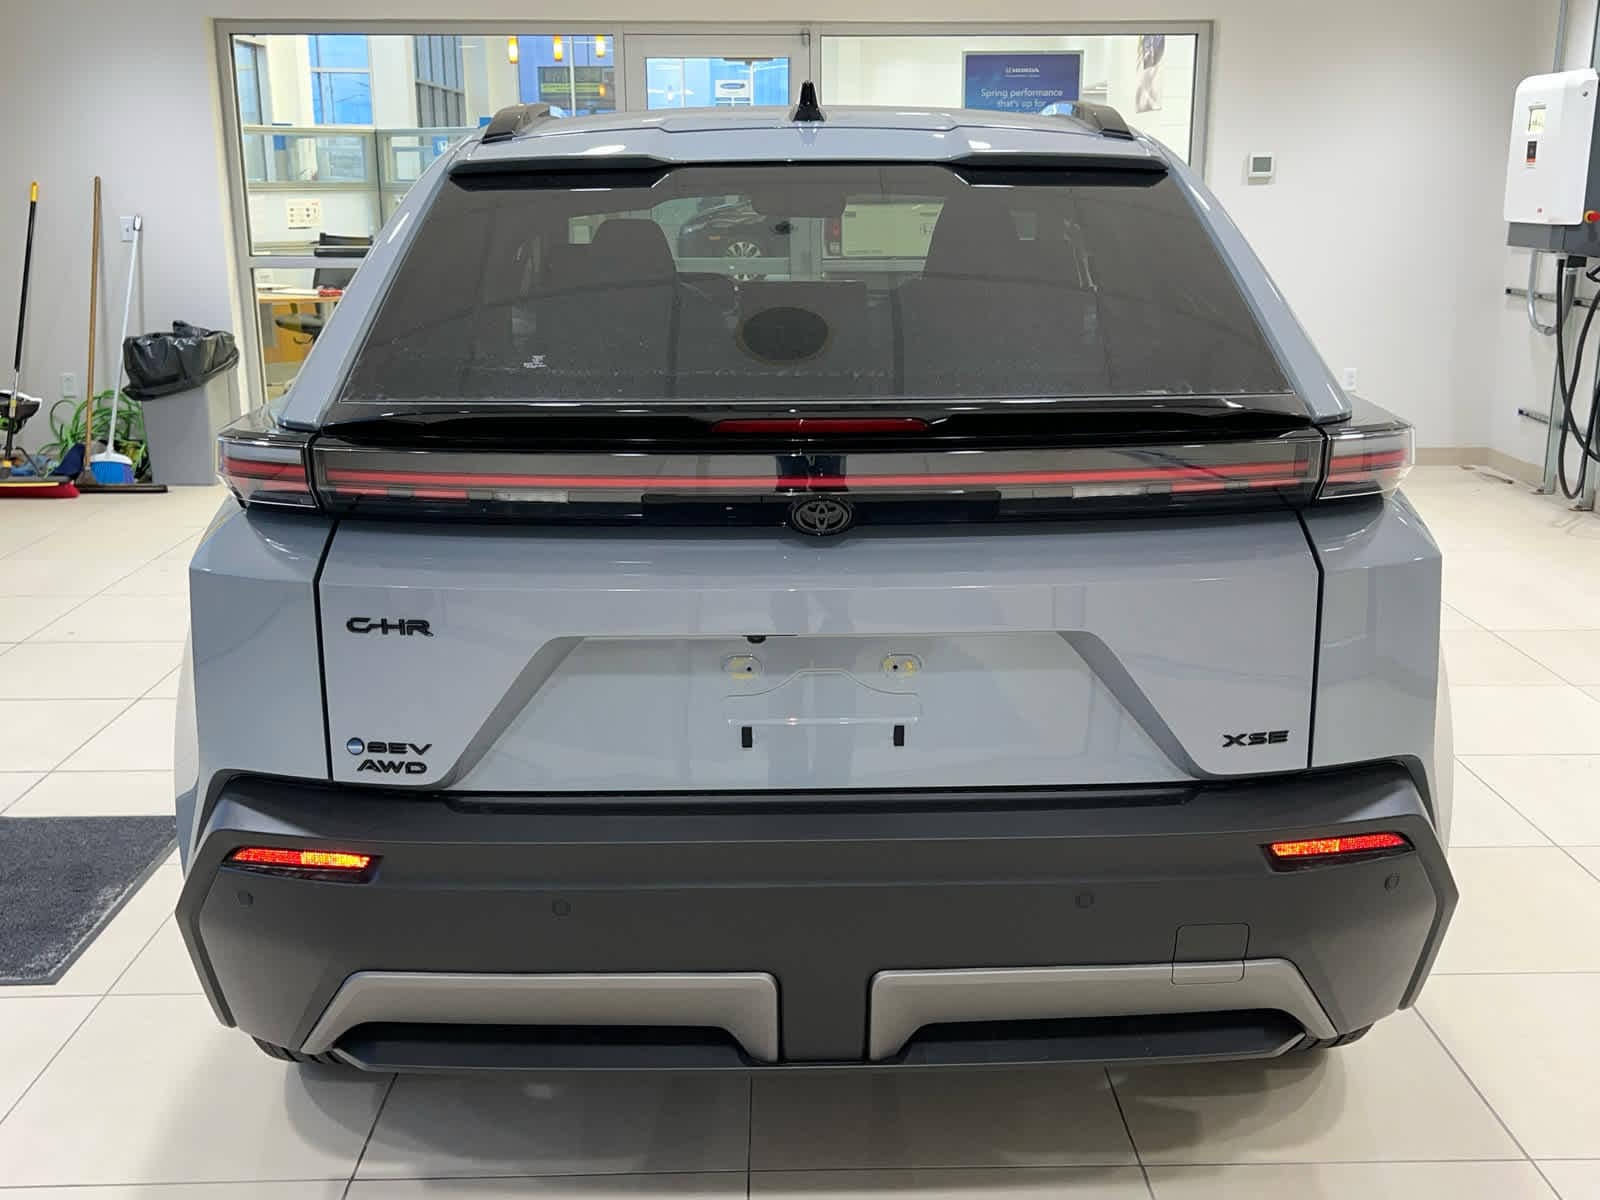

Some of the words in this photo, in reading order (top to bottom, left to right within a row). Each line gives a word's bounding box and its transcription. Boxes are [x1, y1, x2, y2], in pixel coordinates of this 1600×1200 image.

[981, 88, 1008, 99] Spring
[1010, 88, 1063, 99] performance
[997, 99, 1019, 108] that's
[1022, 101, 1033, 109] up
[346, 617, 433, 637] C-HR
[1222, 730, 1290, 748] XSE
[367, 741, 432, 756] BEV
[357, 759, 428, 774] AWD
